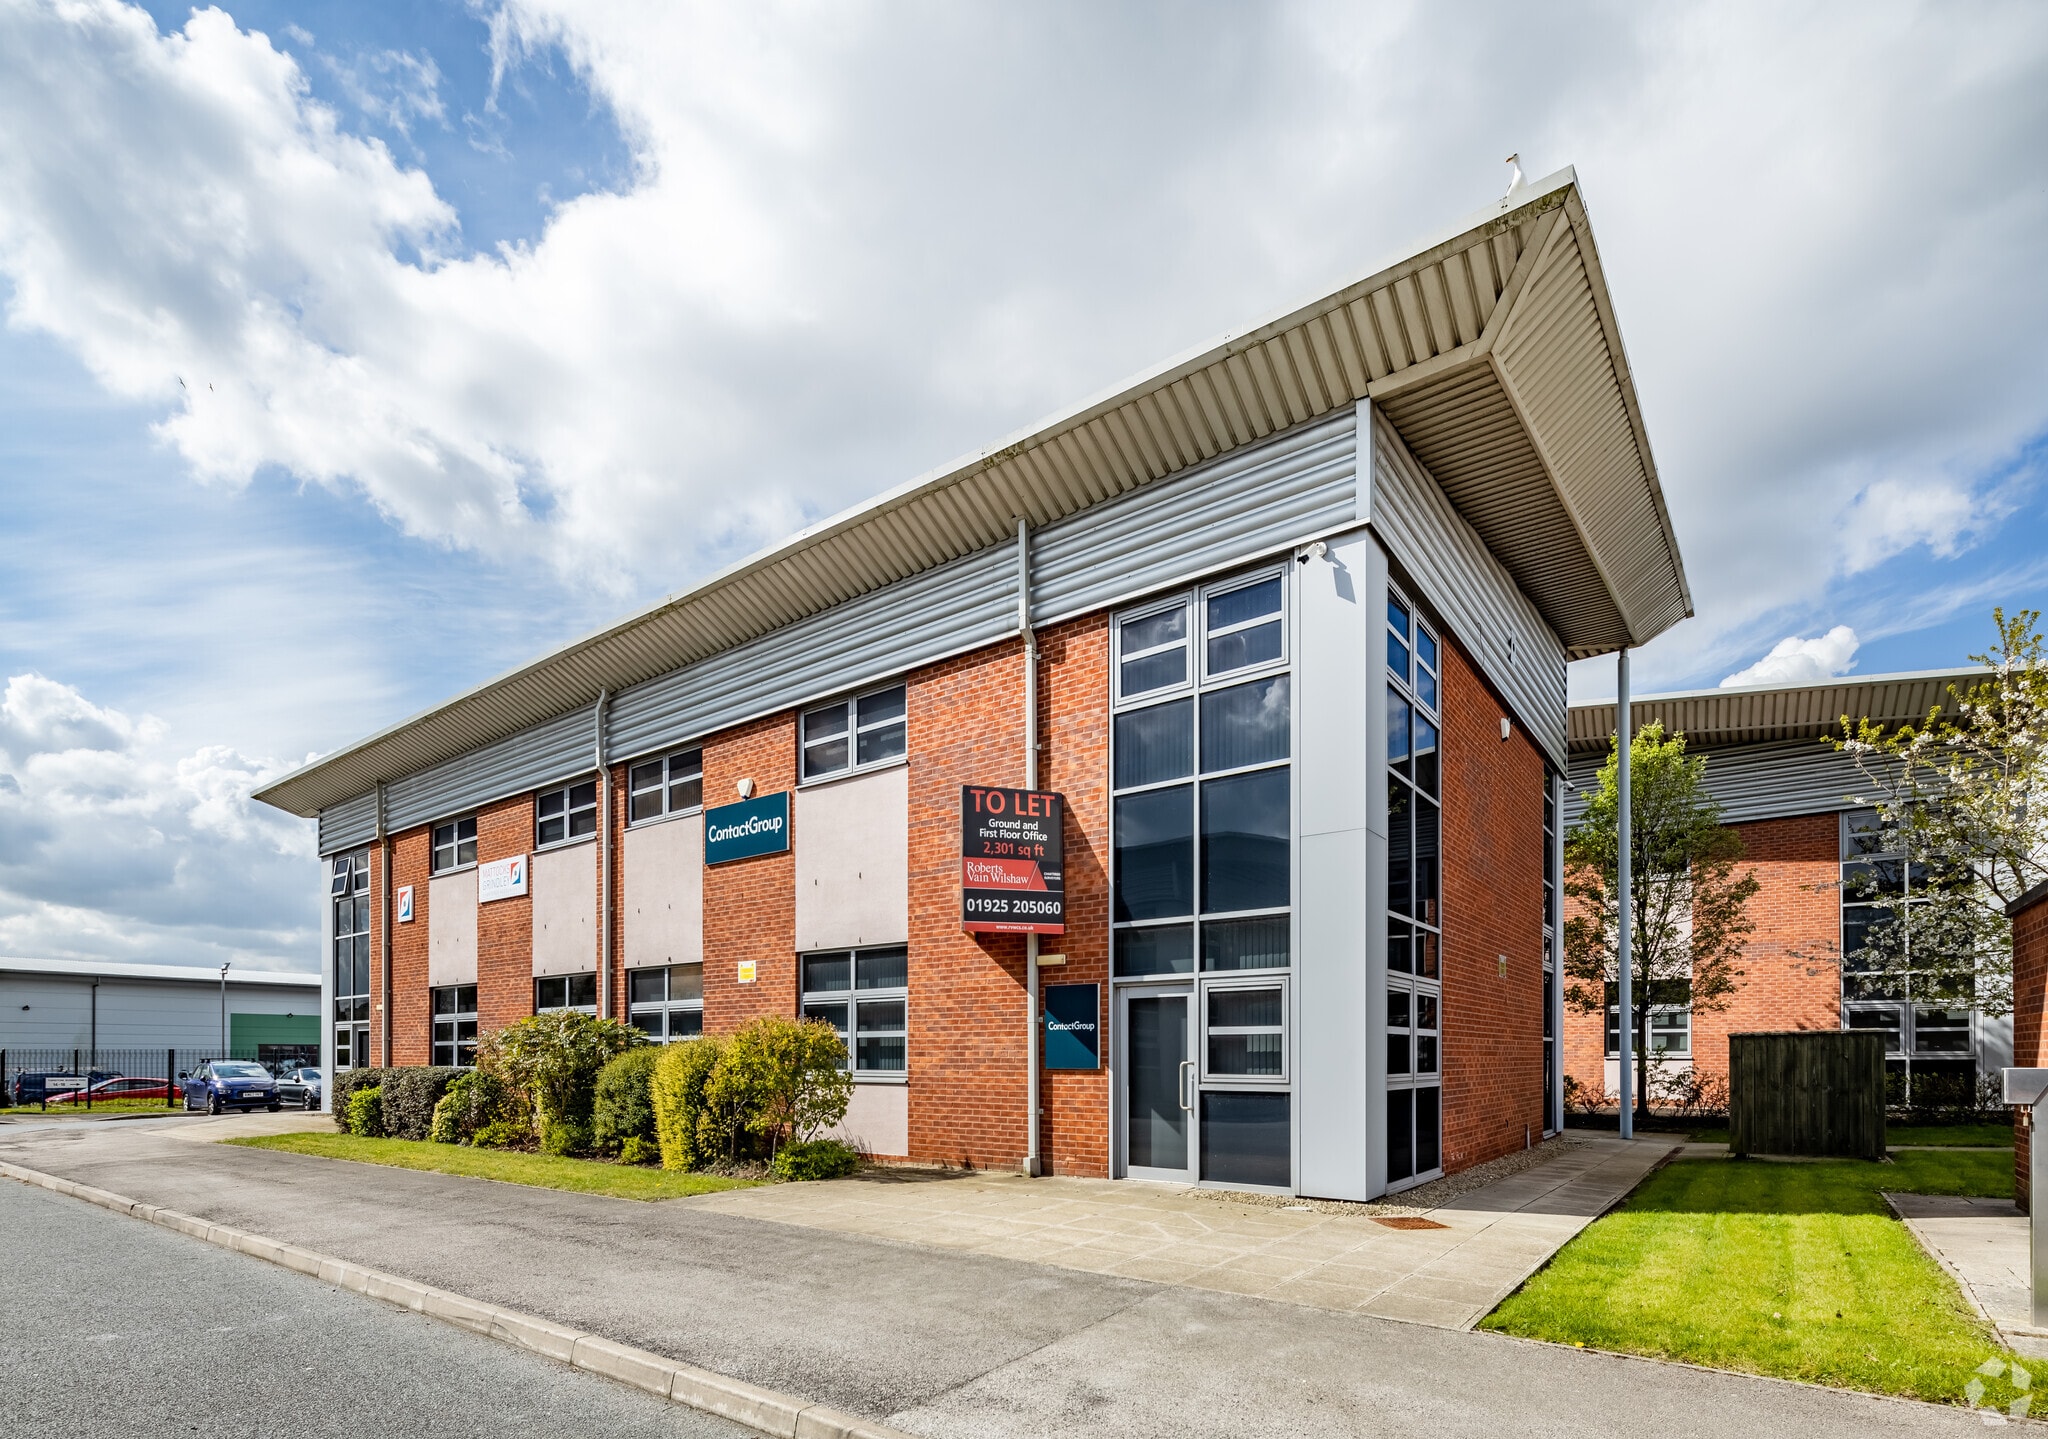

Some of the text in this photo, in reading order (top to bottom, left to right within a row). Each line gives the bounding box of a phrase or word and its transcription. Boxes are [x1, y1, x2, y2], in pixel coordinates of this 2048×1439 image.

[970, 789, 1055, 817] TO LET
[708, 816, 783, 843] ContactGroup
[988, 818, 1038, 830] Ground and
[979, 828, 1048, 841] First Floor Office
[983, 841, 1044, 858] 2,301 sq ft
[967, 861, 1003, 874] Roberts
[967, 871, 989, 883] Vain
[990, 872, 1029, 884] Wilshaw
[966, 898, 1061, 915] 01925 205060
[1048, 1020, 1095, 1032] ContactGroup
